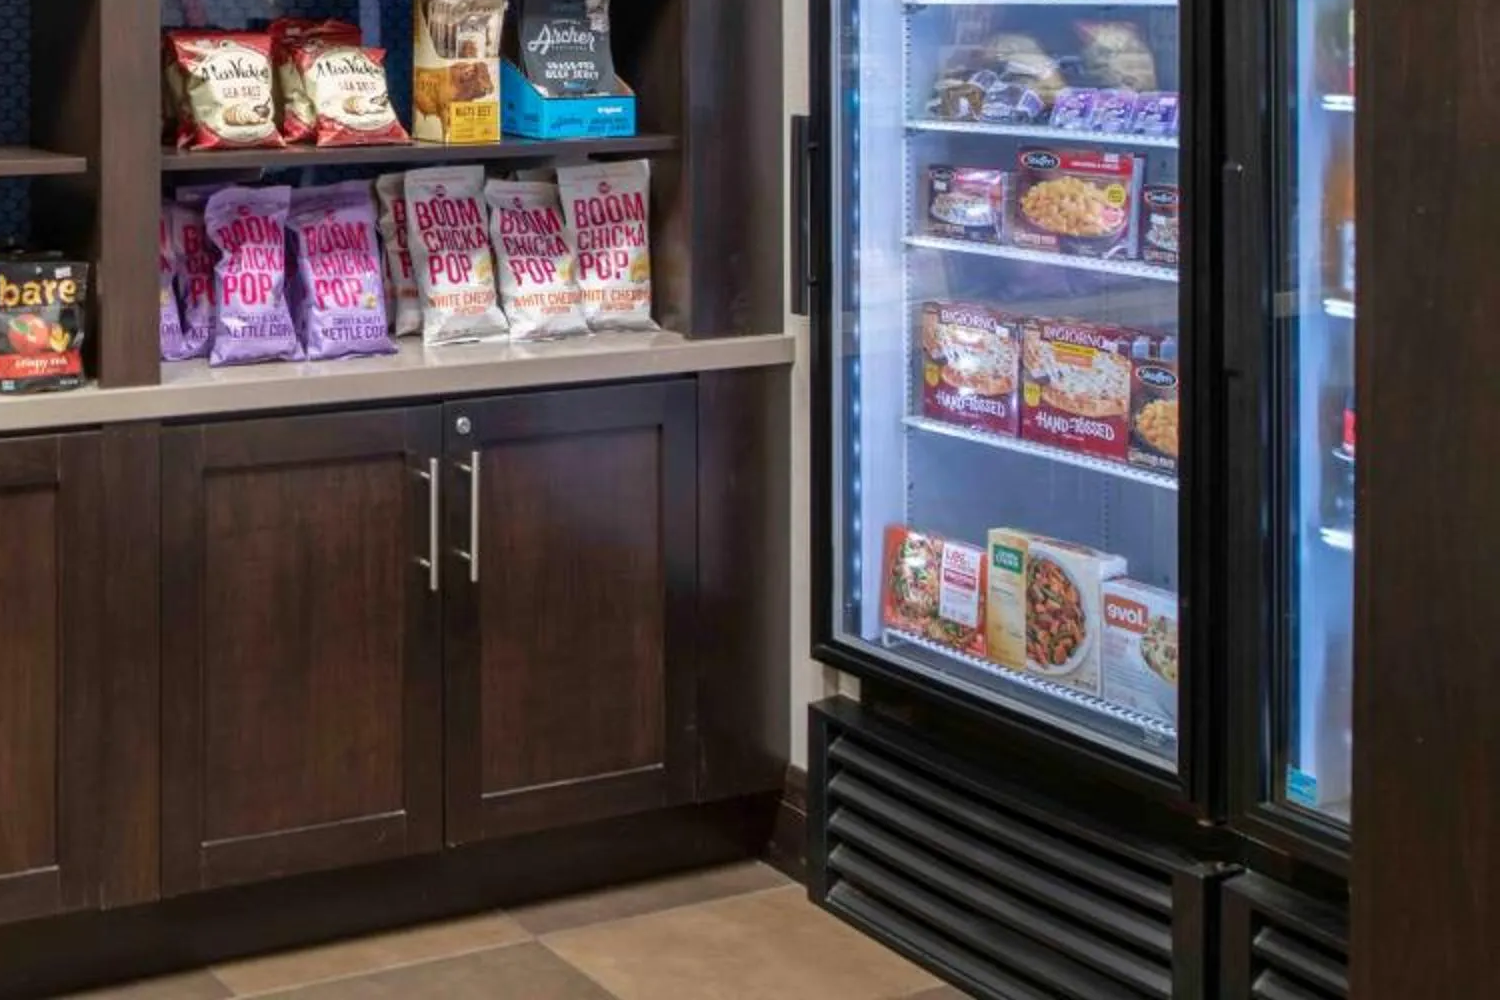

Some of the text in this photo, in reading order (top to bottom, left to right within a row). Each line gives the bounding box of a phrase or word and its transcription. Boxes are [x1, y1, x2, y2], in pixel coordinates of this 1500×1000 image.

[527, 23, 596, 55] Archer
[415, 197, 481, 231] BOOM
[500, 206, 562, 235] BOOM
[573, 191, 646, 229] BOOM
[217, 214, 284, 251] BOOM
[301, 221, 369, 257] BOOM
[423, 225, 488, 253] CHICKA
[502, 234, 570, 258] CHICKA
[577, 223, 646, 251] CHICKA
[428, 252, 472, 285] POP
[509, 257, 557, 288] POP
[579, 251, 630, 281] POP
[222, 274, 273, 306] POP
[314, 277, 364, 312] POP
